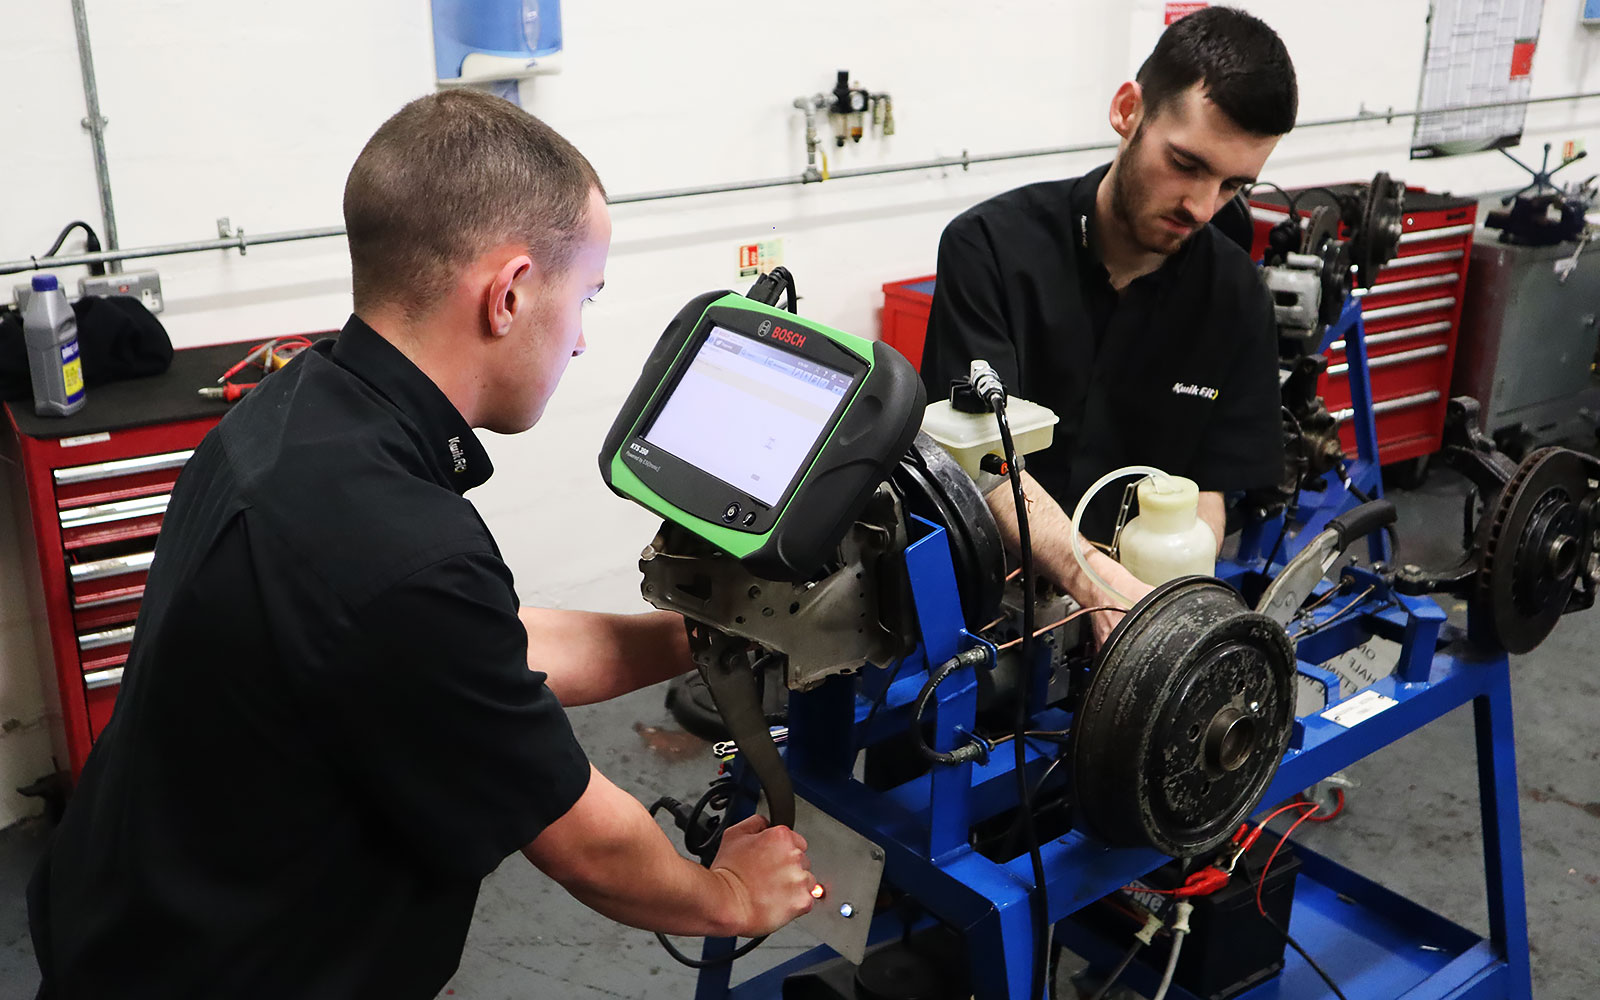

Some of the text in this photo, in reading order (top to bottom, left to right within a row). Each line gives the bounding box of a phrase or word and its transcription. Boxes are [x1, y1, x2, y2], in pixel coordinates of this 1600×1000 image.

[771, 326, 807, 348] BOSCH
[1172, 382, 1200, 396] Kwik
[448, 436, 464, 460] Kwik
[630, 442, 641, 452] KTS
